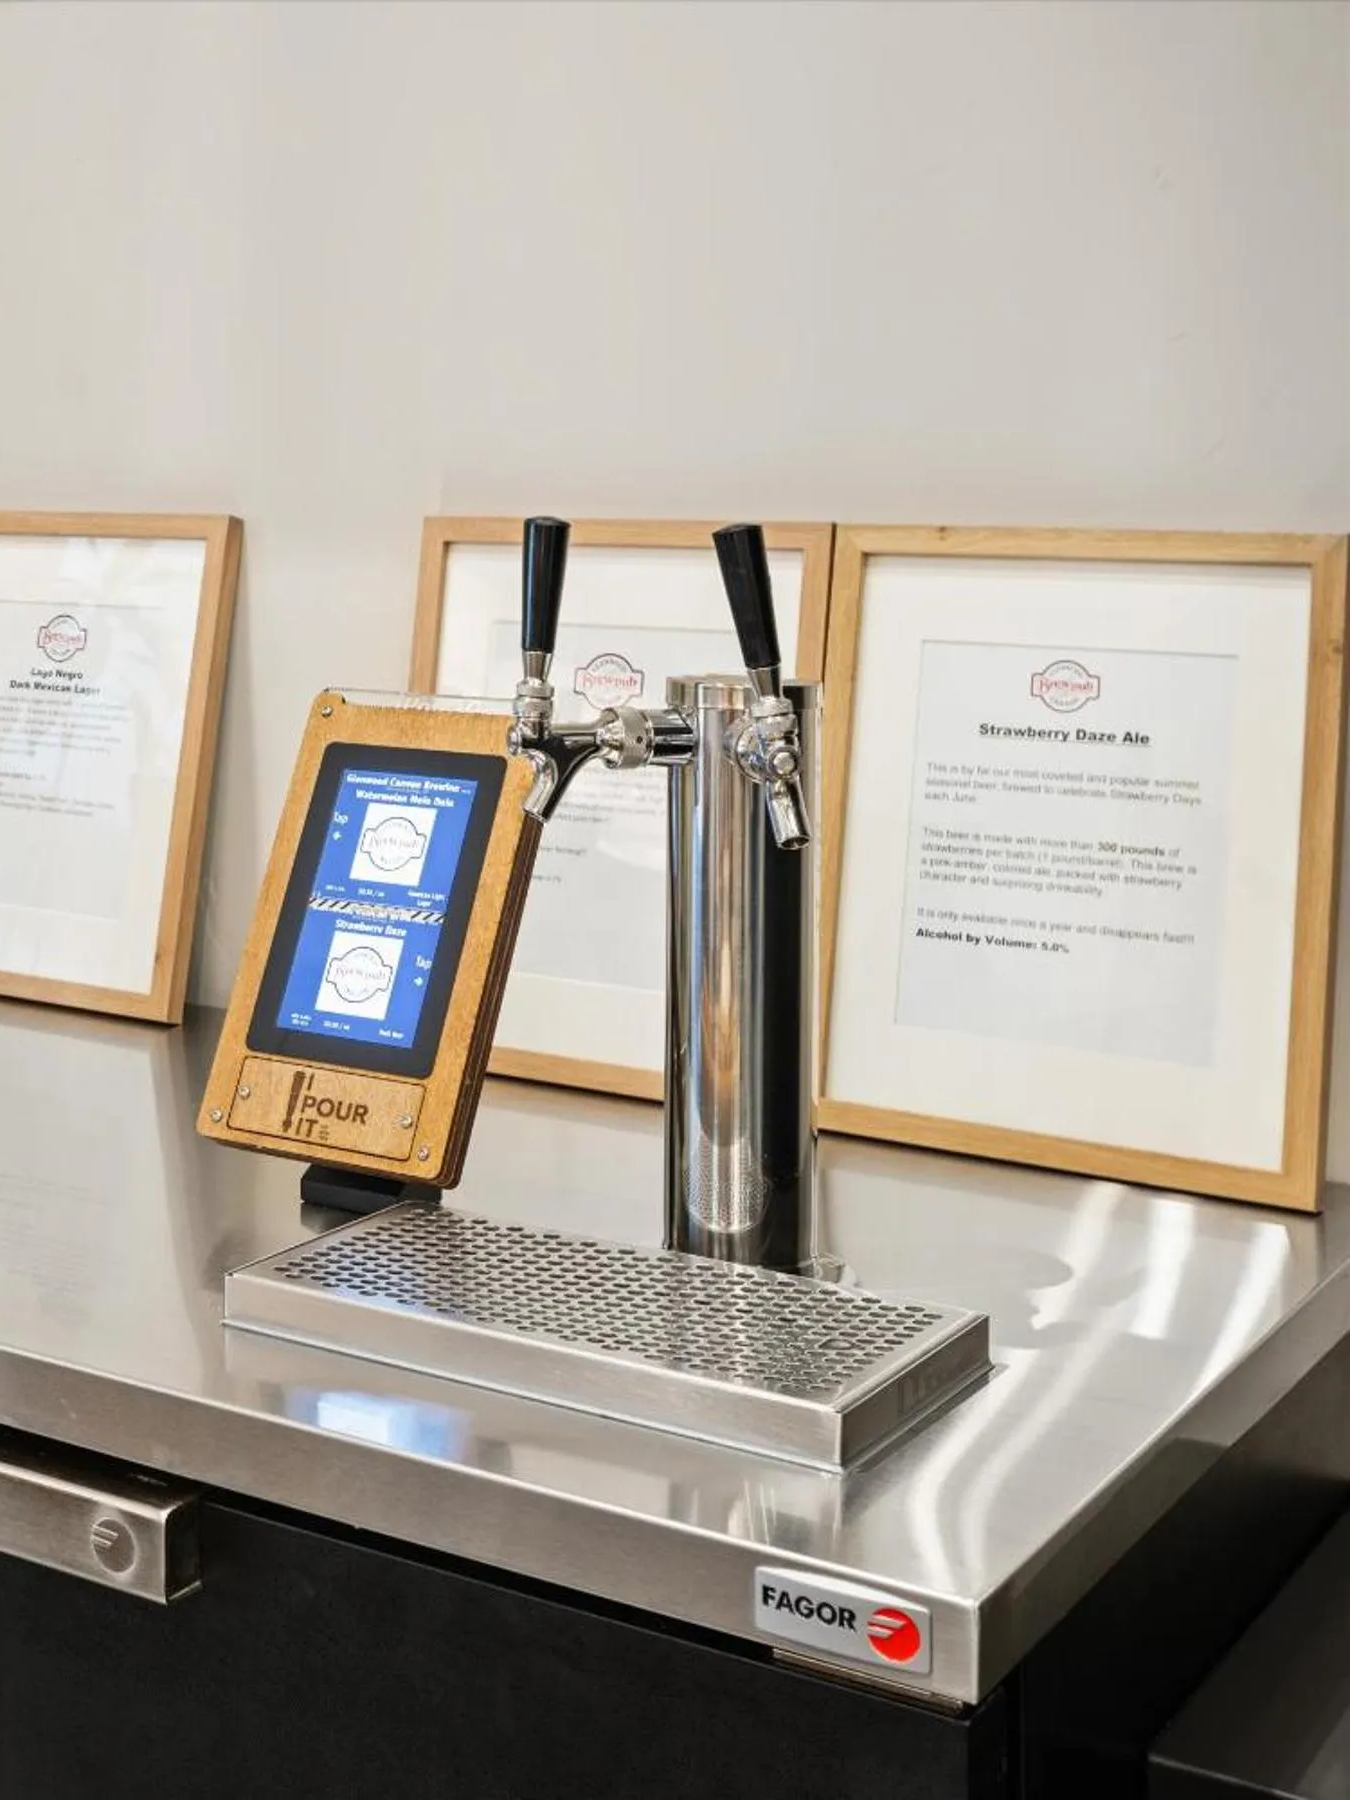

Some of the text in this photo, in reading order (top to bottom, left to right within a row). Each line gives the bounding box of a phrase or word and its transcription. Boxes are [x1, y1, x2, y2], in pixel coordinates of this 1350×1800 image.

[56, 669, 83, 681] Negro
[10, 680, 30, 689] Dark
[33, 681, 70, 692] Mexican
[979, 723, 1150, 745] Strawberry Daze Ale
[1121, 844, 1165, 857] pounds
[916, 927, 1070, 954] Alcohol by Volume: 5.0%
[300, 1095, 369, 1125] POUR
[295, 1118, 319, 1138] IT
[762, 1584, 858, 1633] FAGOR
